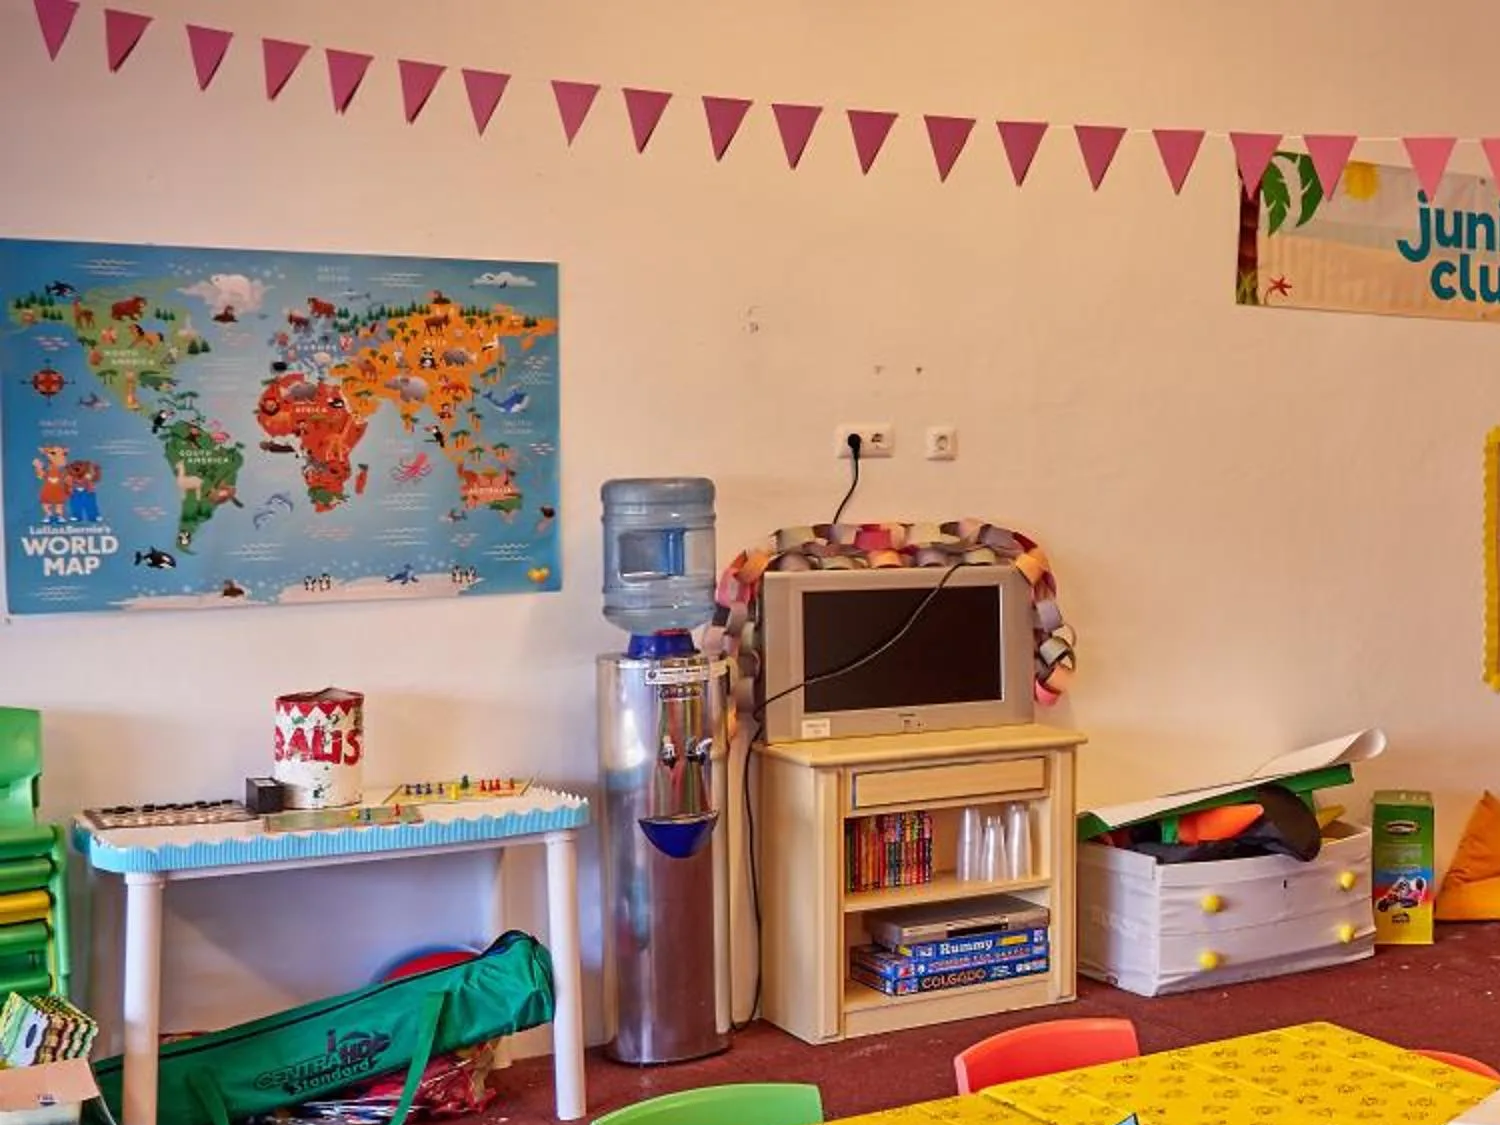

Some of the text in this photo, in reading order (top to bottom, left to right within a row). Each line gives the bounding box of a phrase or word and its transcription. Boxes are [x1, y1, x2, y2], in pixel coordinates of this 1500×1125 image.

[21, 535, 120, 556] WORLD
[43, 555, 101, 577] MAP
[939, 938, 993, 955] Rummy
[292, 1060, 371, 1093] Standard
